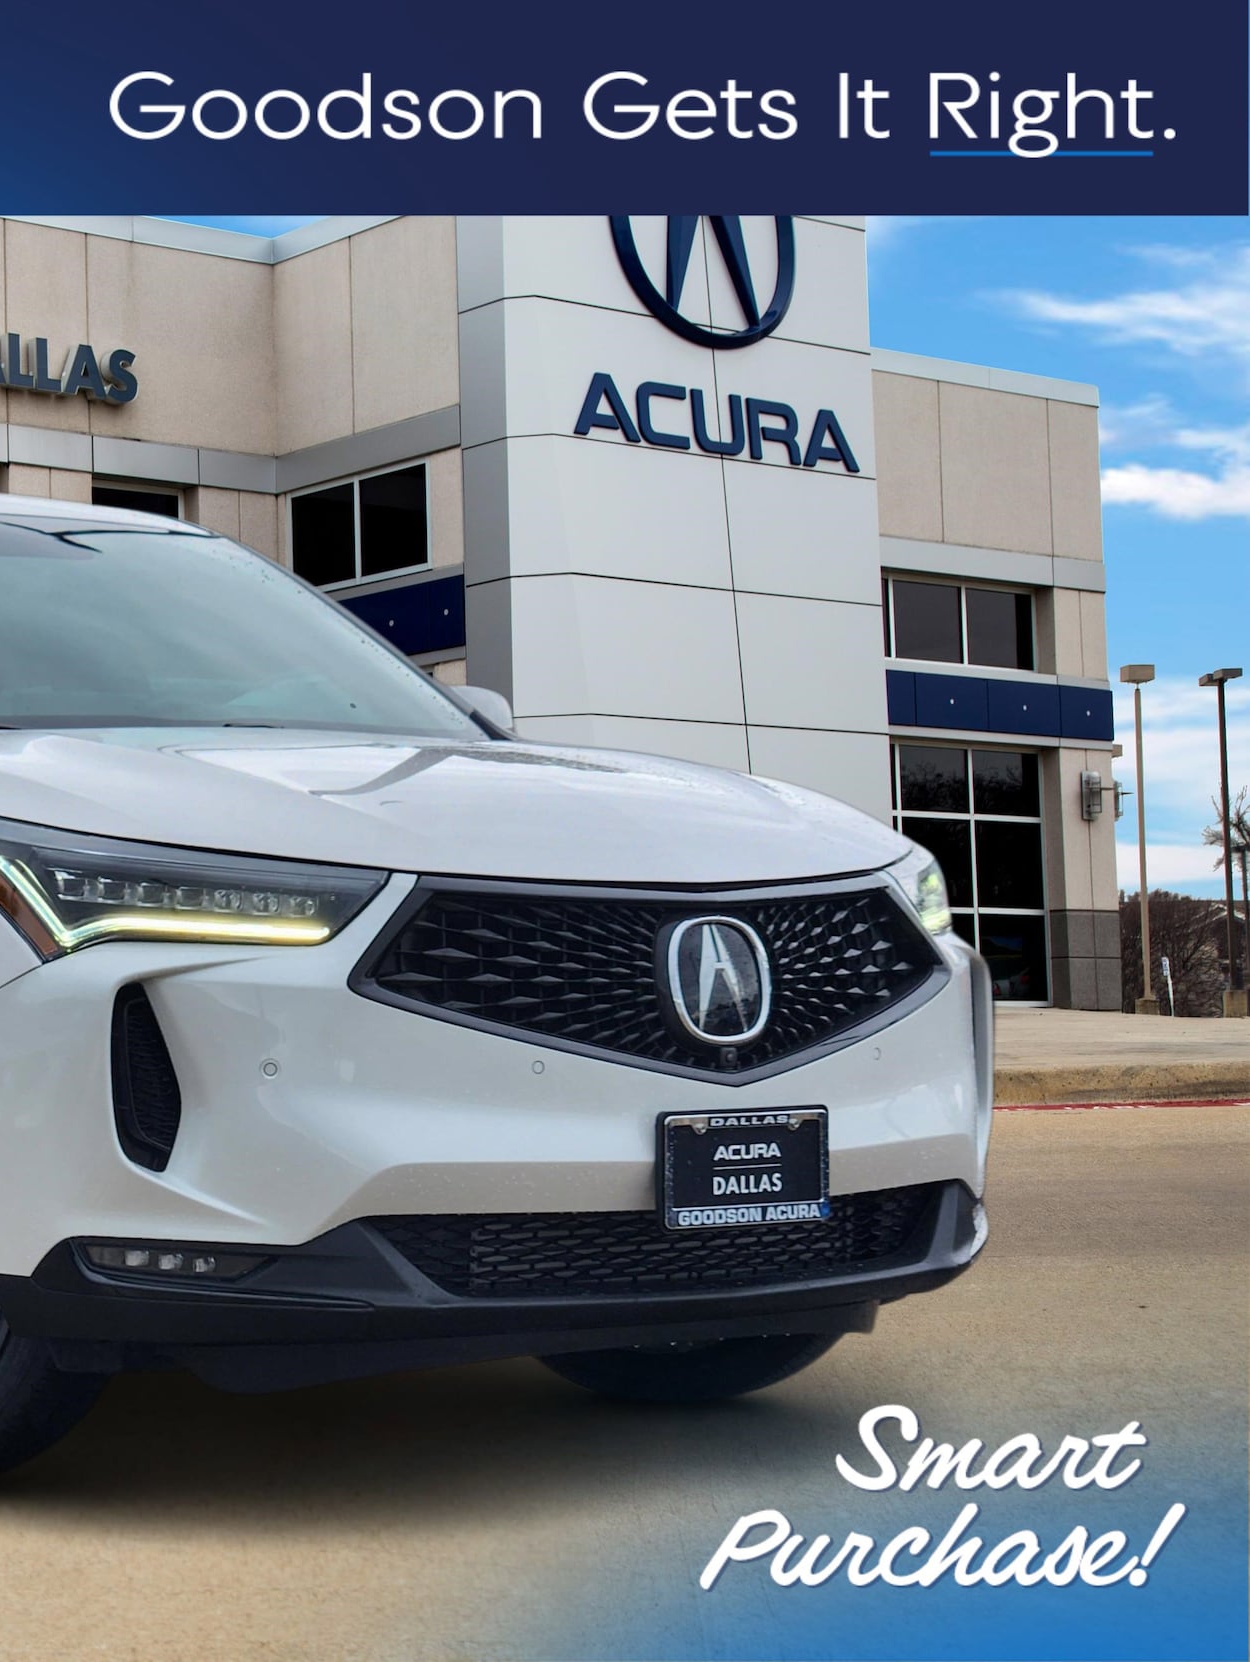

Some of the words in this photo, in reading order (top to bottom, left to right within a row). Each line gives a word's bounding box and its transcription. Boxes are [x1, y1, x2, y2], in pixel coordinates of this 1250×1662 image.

[574, 372, 860, 473] ACURA
[710, 1115, 789, 1127] DALLAS
[713, 1142, 782, 1161] ACURA
[712, 1173, 783, 1196] DALLAS
[678, 1206, 762, 1226] GOODSON
[765, 1203, 821, 1222] ACURA
